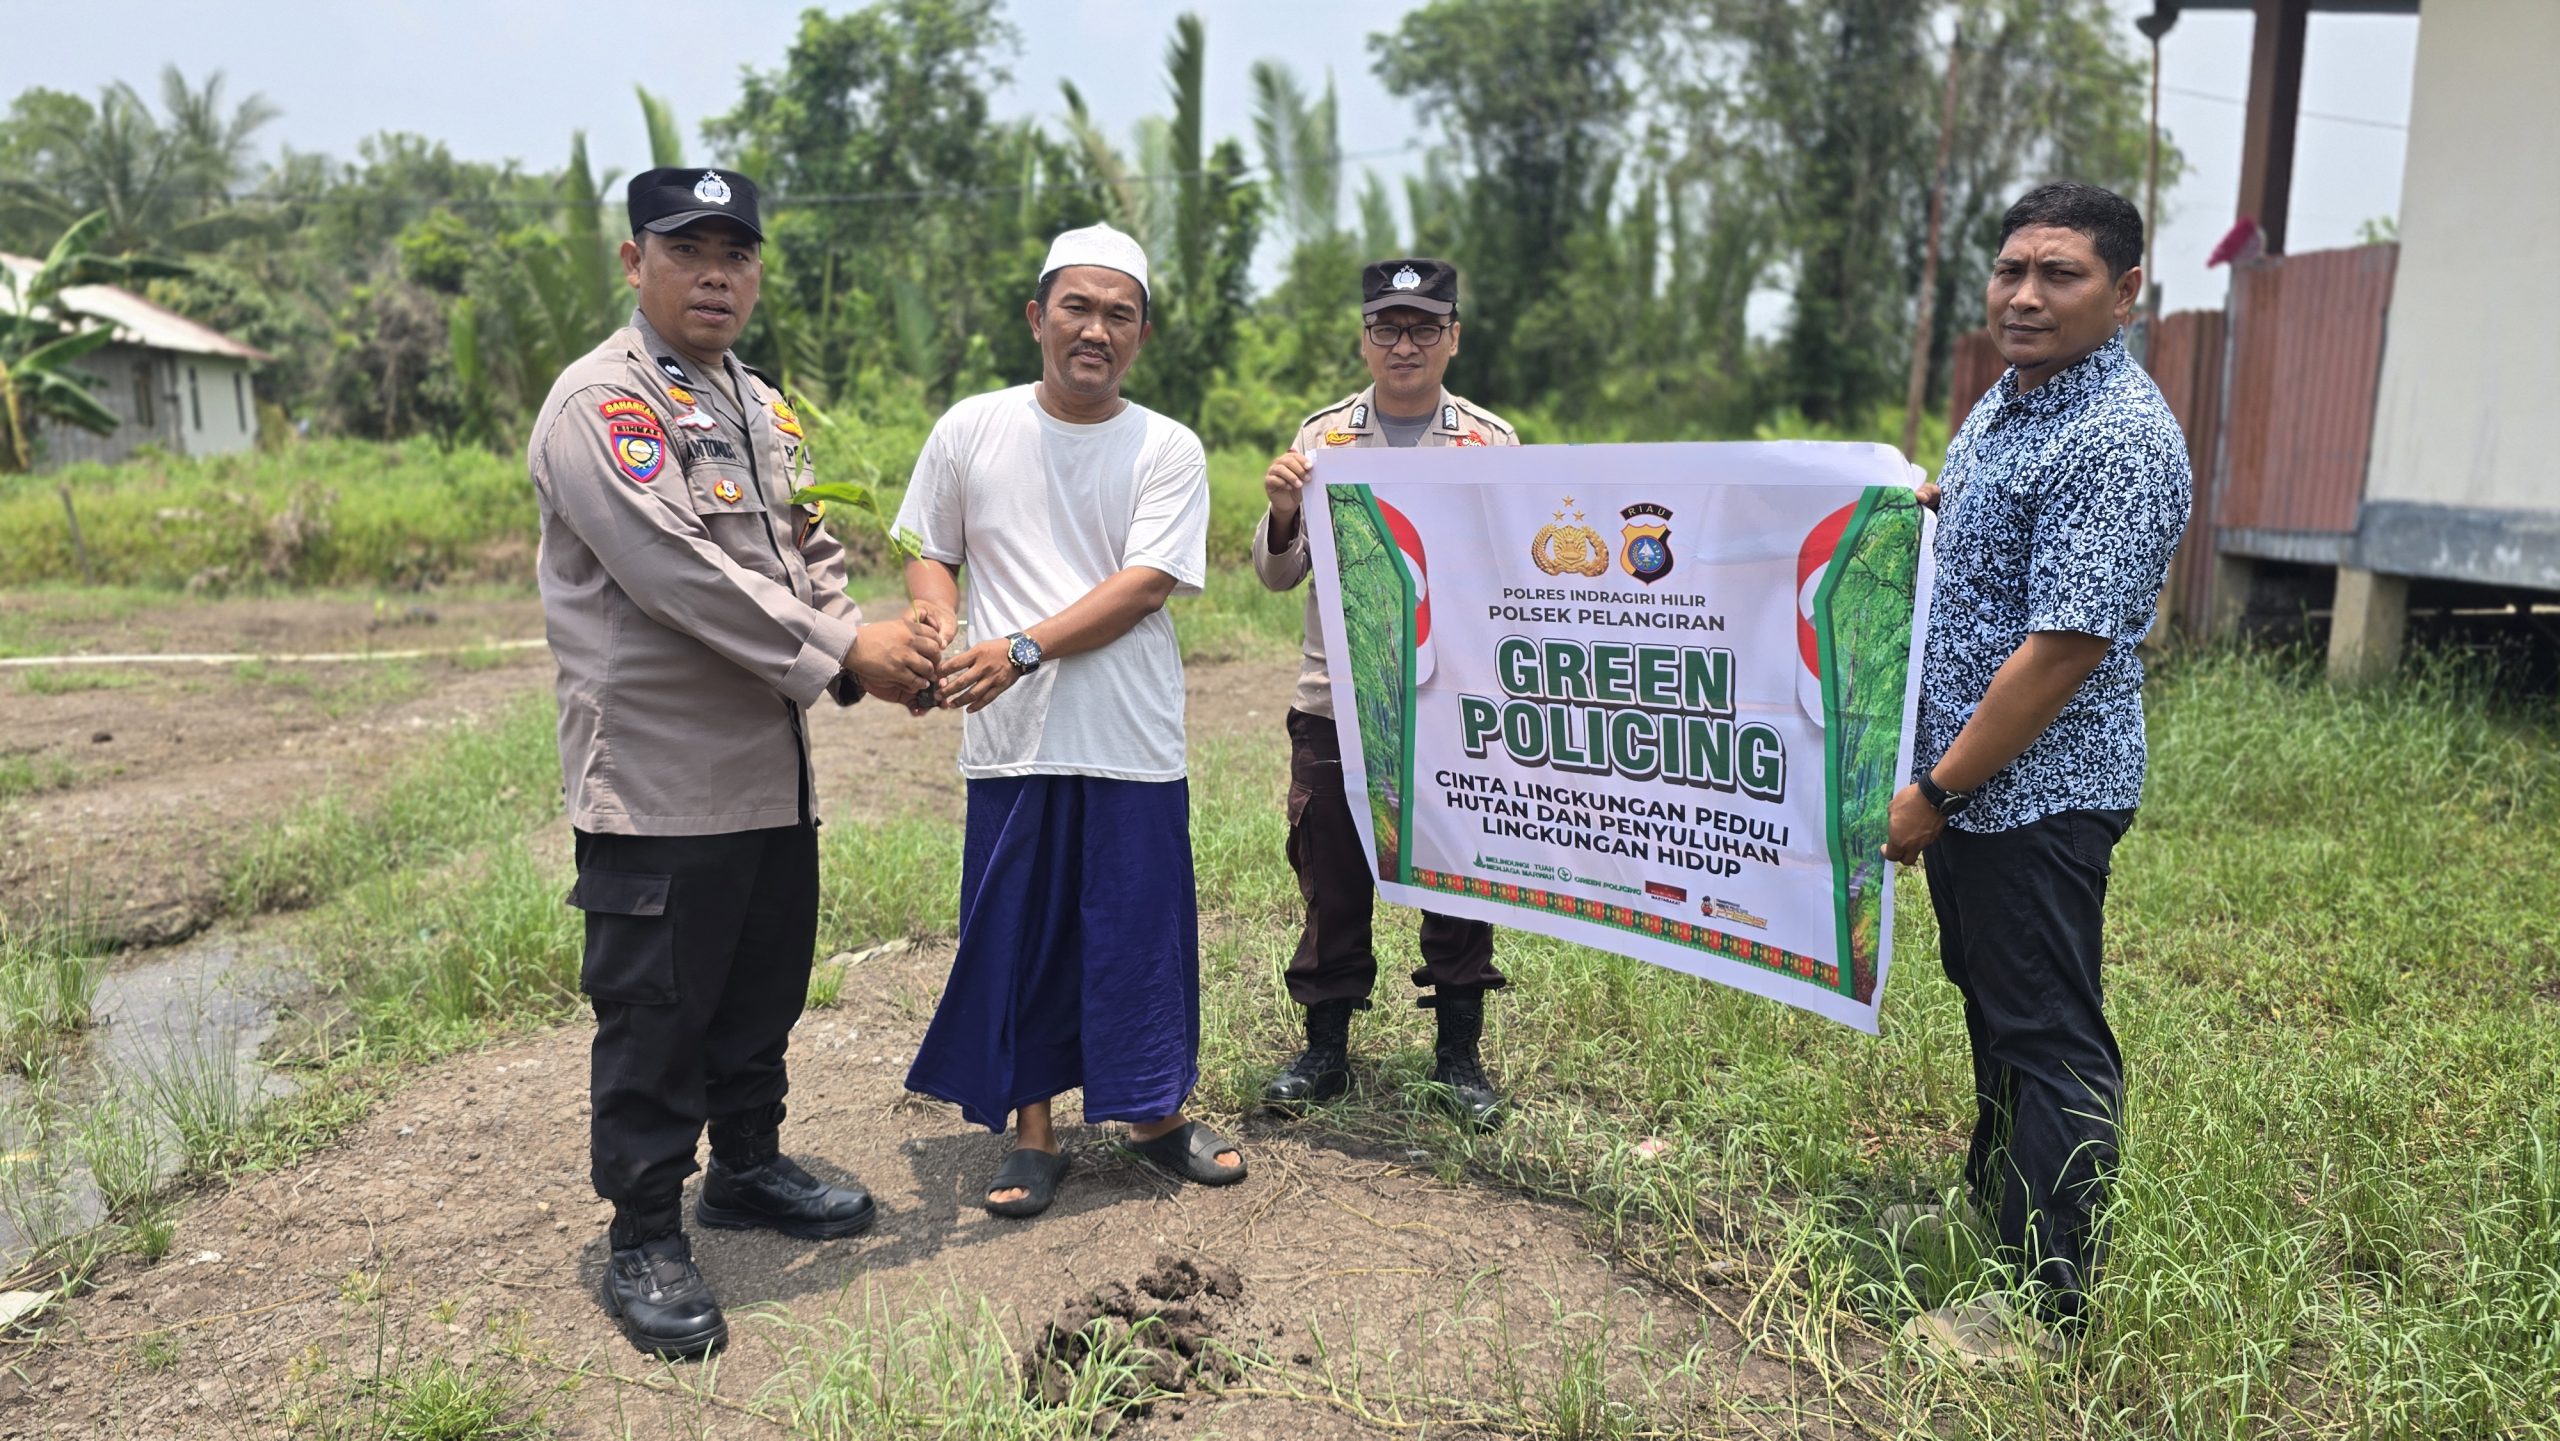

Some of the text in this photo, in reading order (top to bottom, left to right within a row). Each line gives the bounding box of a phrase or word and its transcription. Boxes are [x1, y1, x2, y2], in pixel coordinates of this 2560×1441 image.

[1628, 505, 1665, 516] RIAU
[1503, 588, 1706, 607] POLRES INDRAGIRI HILIR
[1489, 605, 1725, 631] POLSEK PELANGIRAN
[1495, 635, 1736, 716] GREEN
[1458, 694, 1787, 803] POLICING
[1435, 770, 1789, 847] CINTA LINGKUNGAN PEDULI
[1446, 792, 1780, 866] HUTAN DAN PENYULUHAN
[1482, 816, 1741, 878] LINGKUNGAN HIDUP
[1485, 856, 1554, 873] MELINDUNGI TUAH
[1522, 870, 1555, 881] MARWAH
[1574, 876, 1601, 887] GREEN
[1603, 882, 1641, 895] POLICING
